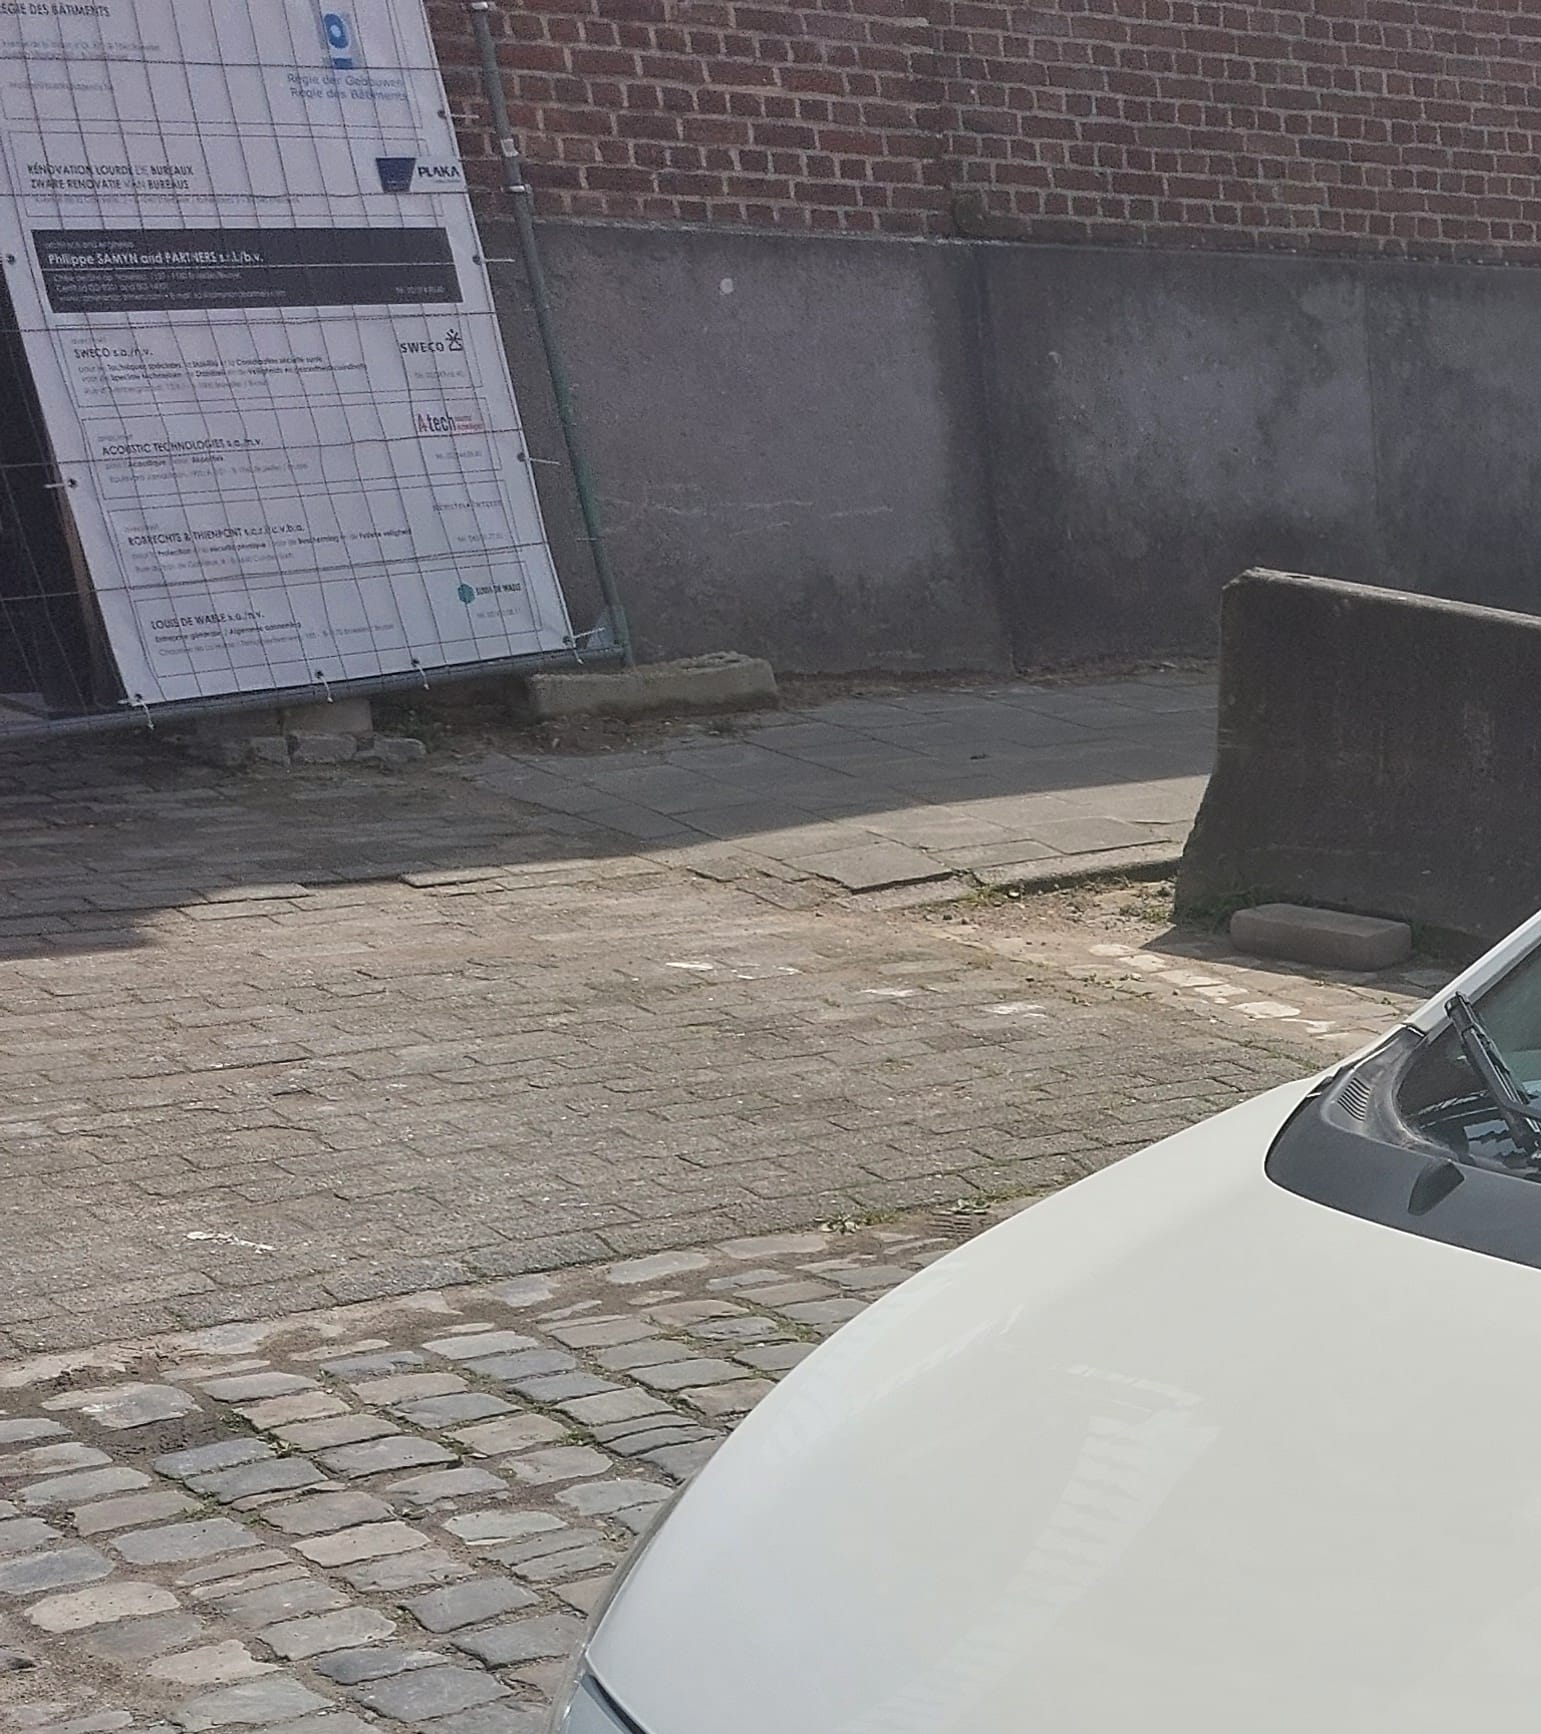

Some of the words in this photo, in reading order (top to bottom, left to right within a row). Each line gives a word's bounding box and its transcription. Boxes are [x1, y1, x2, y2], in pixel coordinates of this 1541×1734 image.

[29, 3, 49, 15] DES
[150, 165, 194, 175] BUREAUX
[417, 166, 461, 178] PLAKA
[67, 179, 121, 189] RENOVATIE
[96, 252, 138, 265] SAMYN
[140, 252, 163, 264] and
[73, 347, 111, 359] SWECO
[400, 342, 445, 354] SWECO
[152, 438, 225, 453] TECHNOLOGIES
[180, 617, 194, 627] DE
